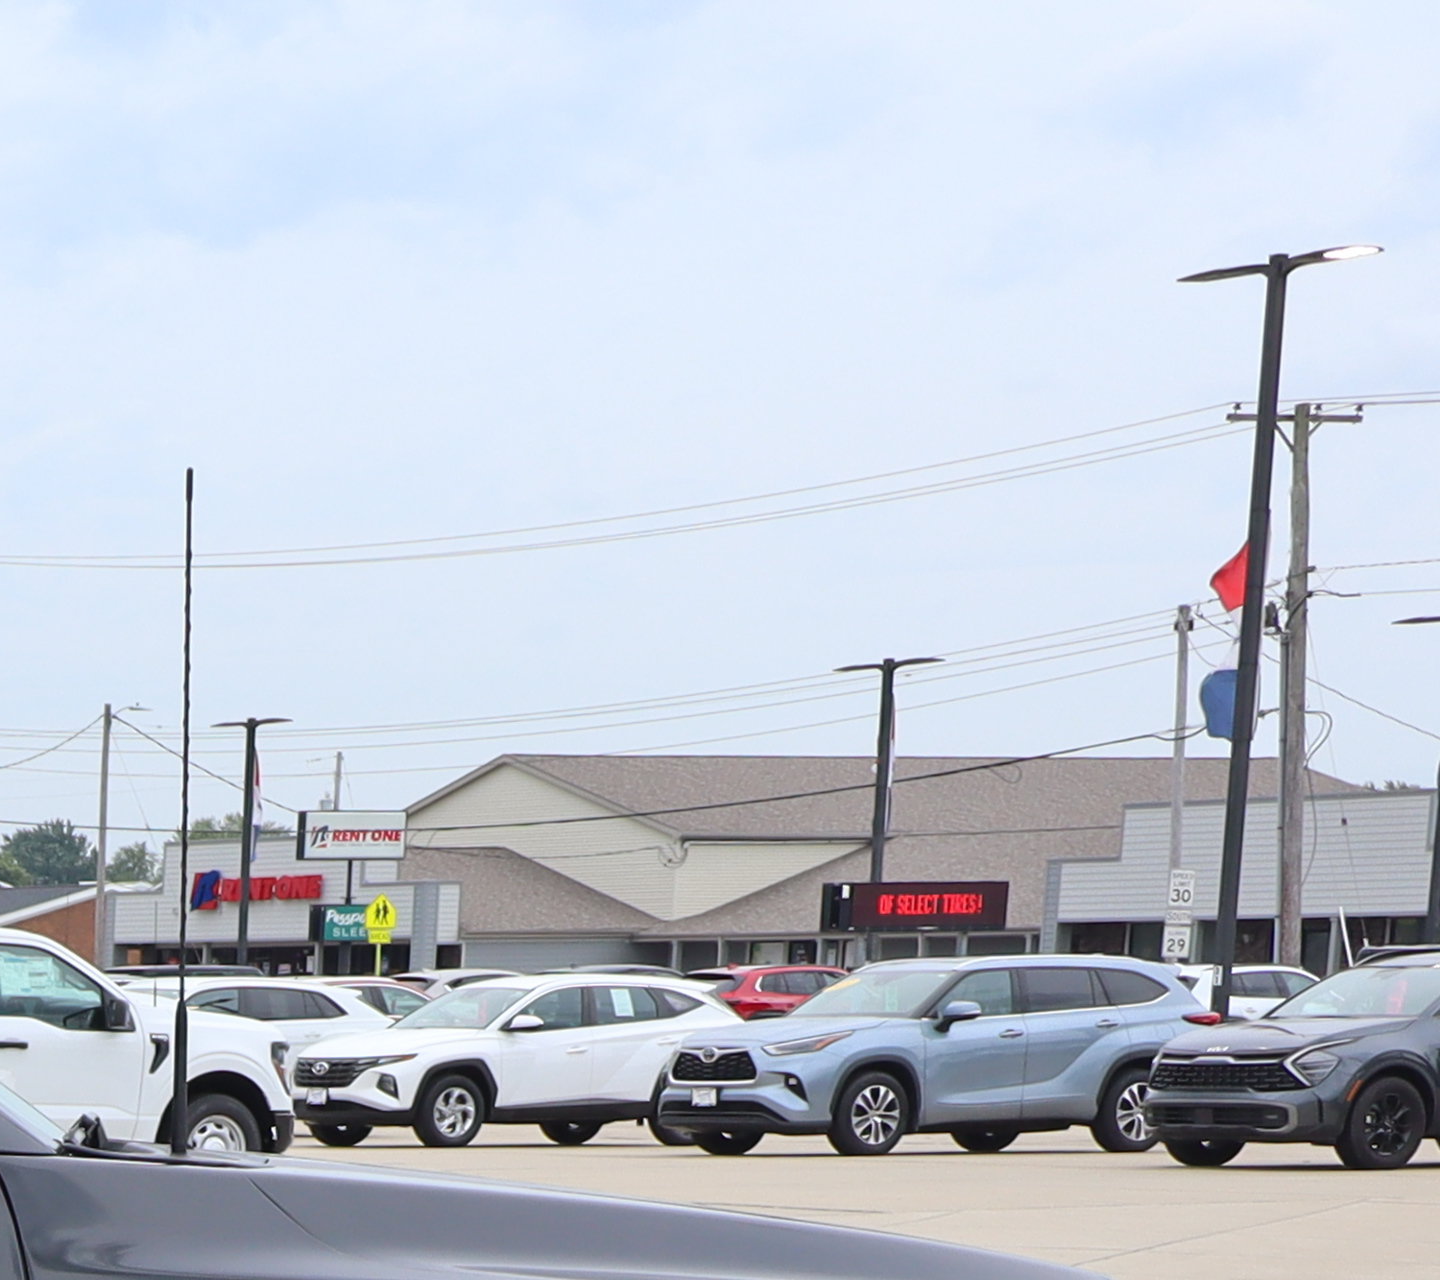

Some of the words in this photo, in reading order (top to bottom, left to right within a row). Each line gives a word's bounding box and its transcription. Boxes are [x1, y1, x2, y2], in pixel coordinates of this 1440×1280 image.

[332, 829, 369, 842] RENT
[370, 830, 401, 842] ONE
[276, 875, 322, 900] ONE
[1170, 888, 1191, 902] 30
[879, 894, 893, 915] OF
[896, 893, 939, 915] SELECT
[942, 893, 983, 914] TIRES!
[1167, 912, 1191, 921] SOUTH
[333, 926, 366, 937] SLEE
[1166, 938, 1186, 952] 29
